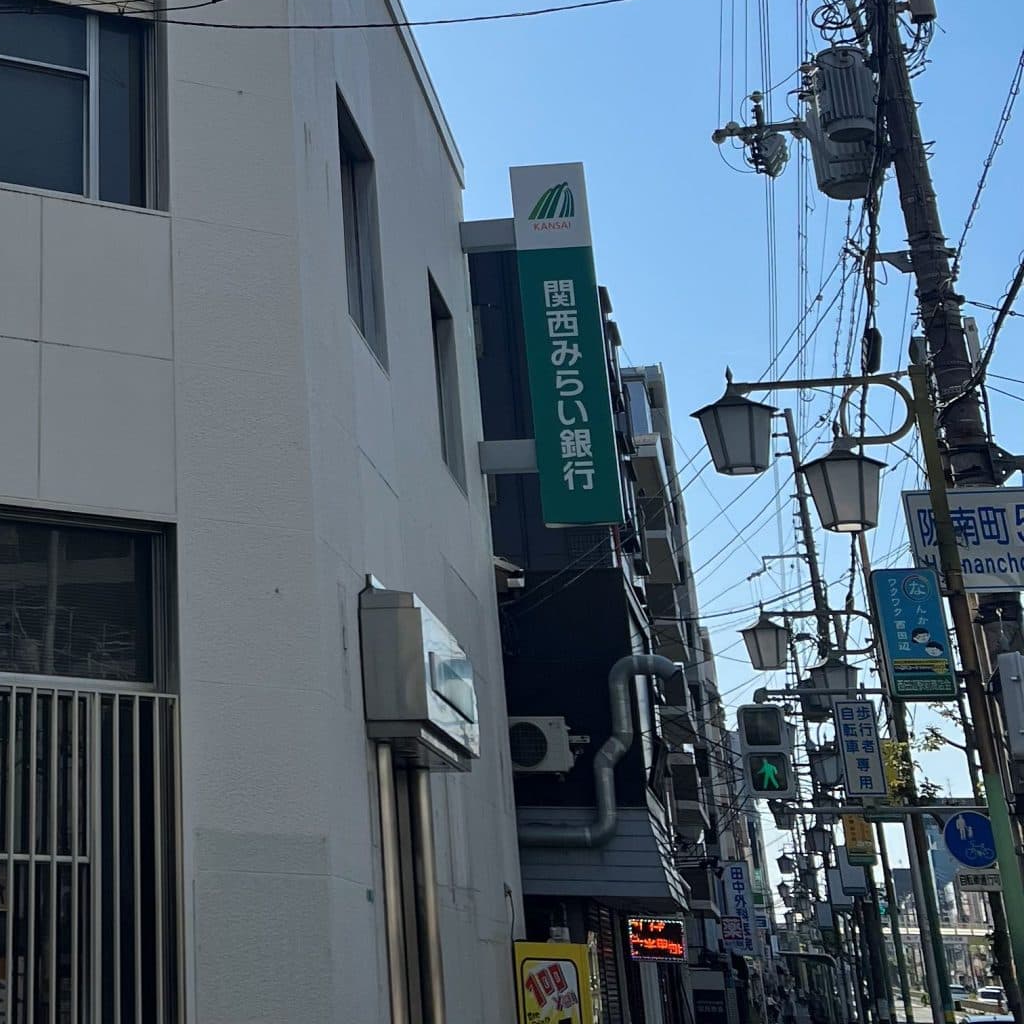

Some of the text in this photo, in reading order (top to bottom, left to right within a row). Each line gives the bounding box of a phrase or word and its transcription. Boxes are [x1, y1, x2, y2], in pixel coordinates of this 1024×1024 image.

[533, 221, 572, 231] KANSAI
[543, 279, 596, 491] 関西みらい銀行
[841, 707, 860, 754] 自転車
[856, 706, 875, 790] 歩行者専用
